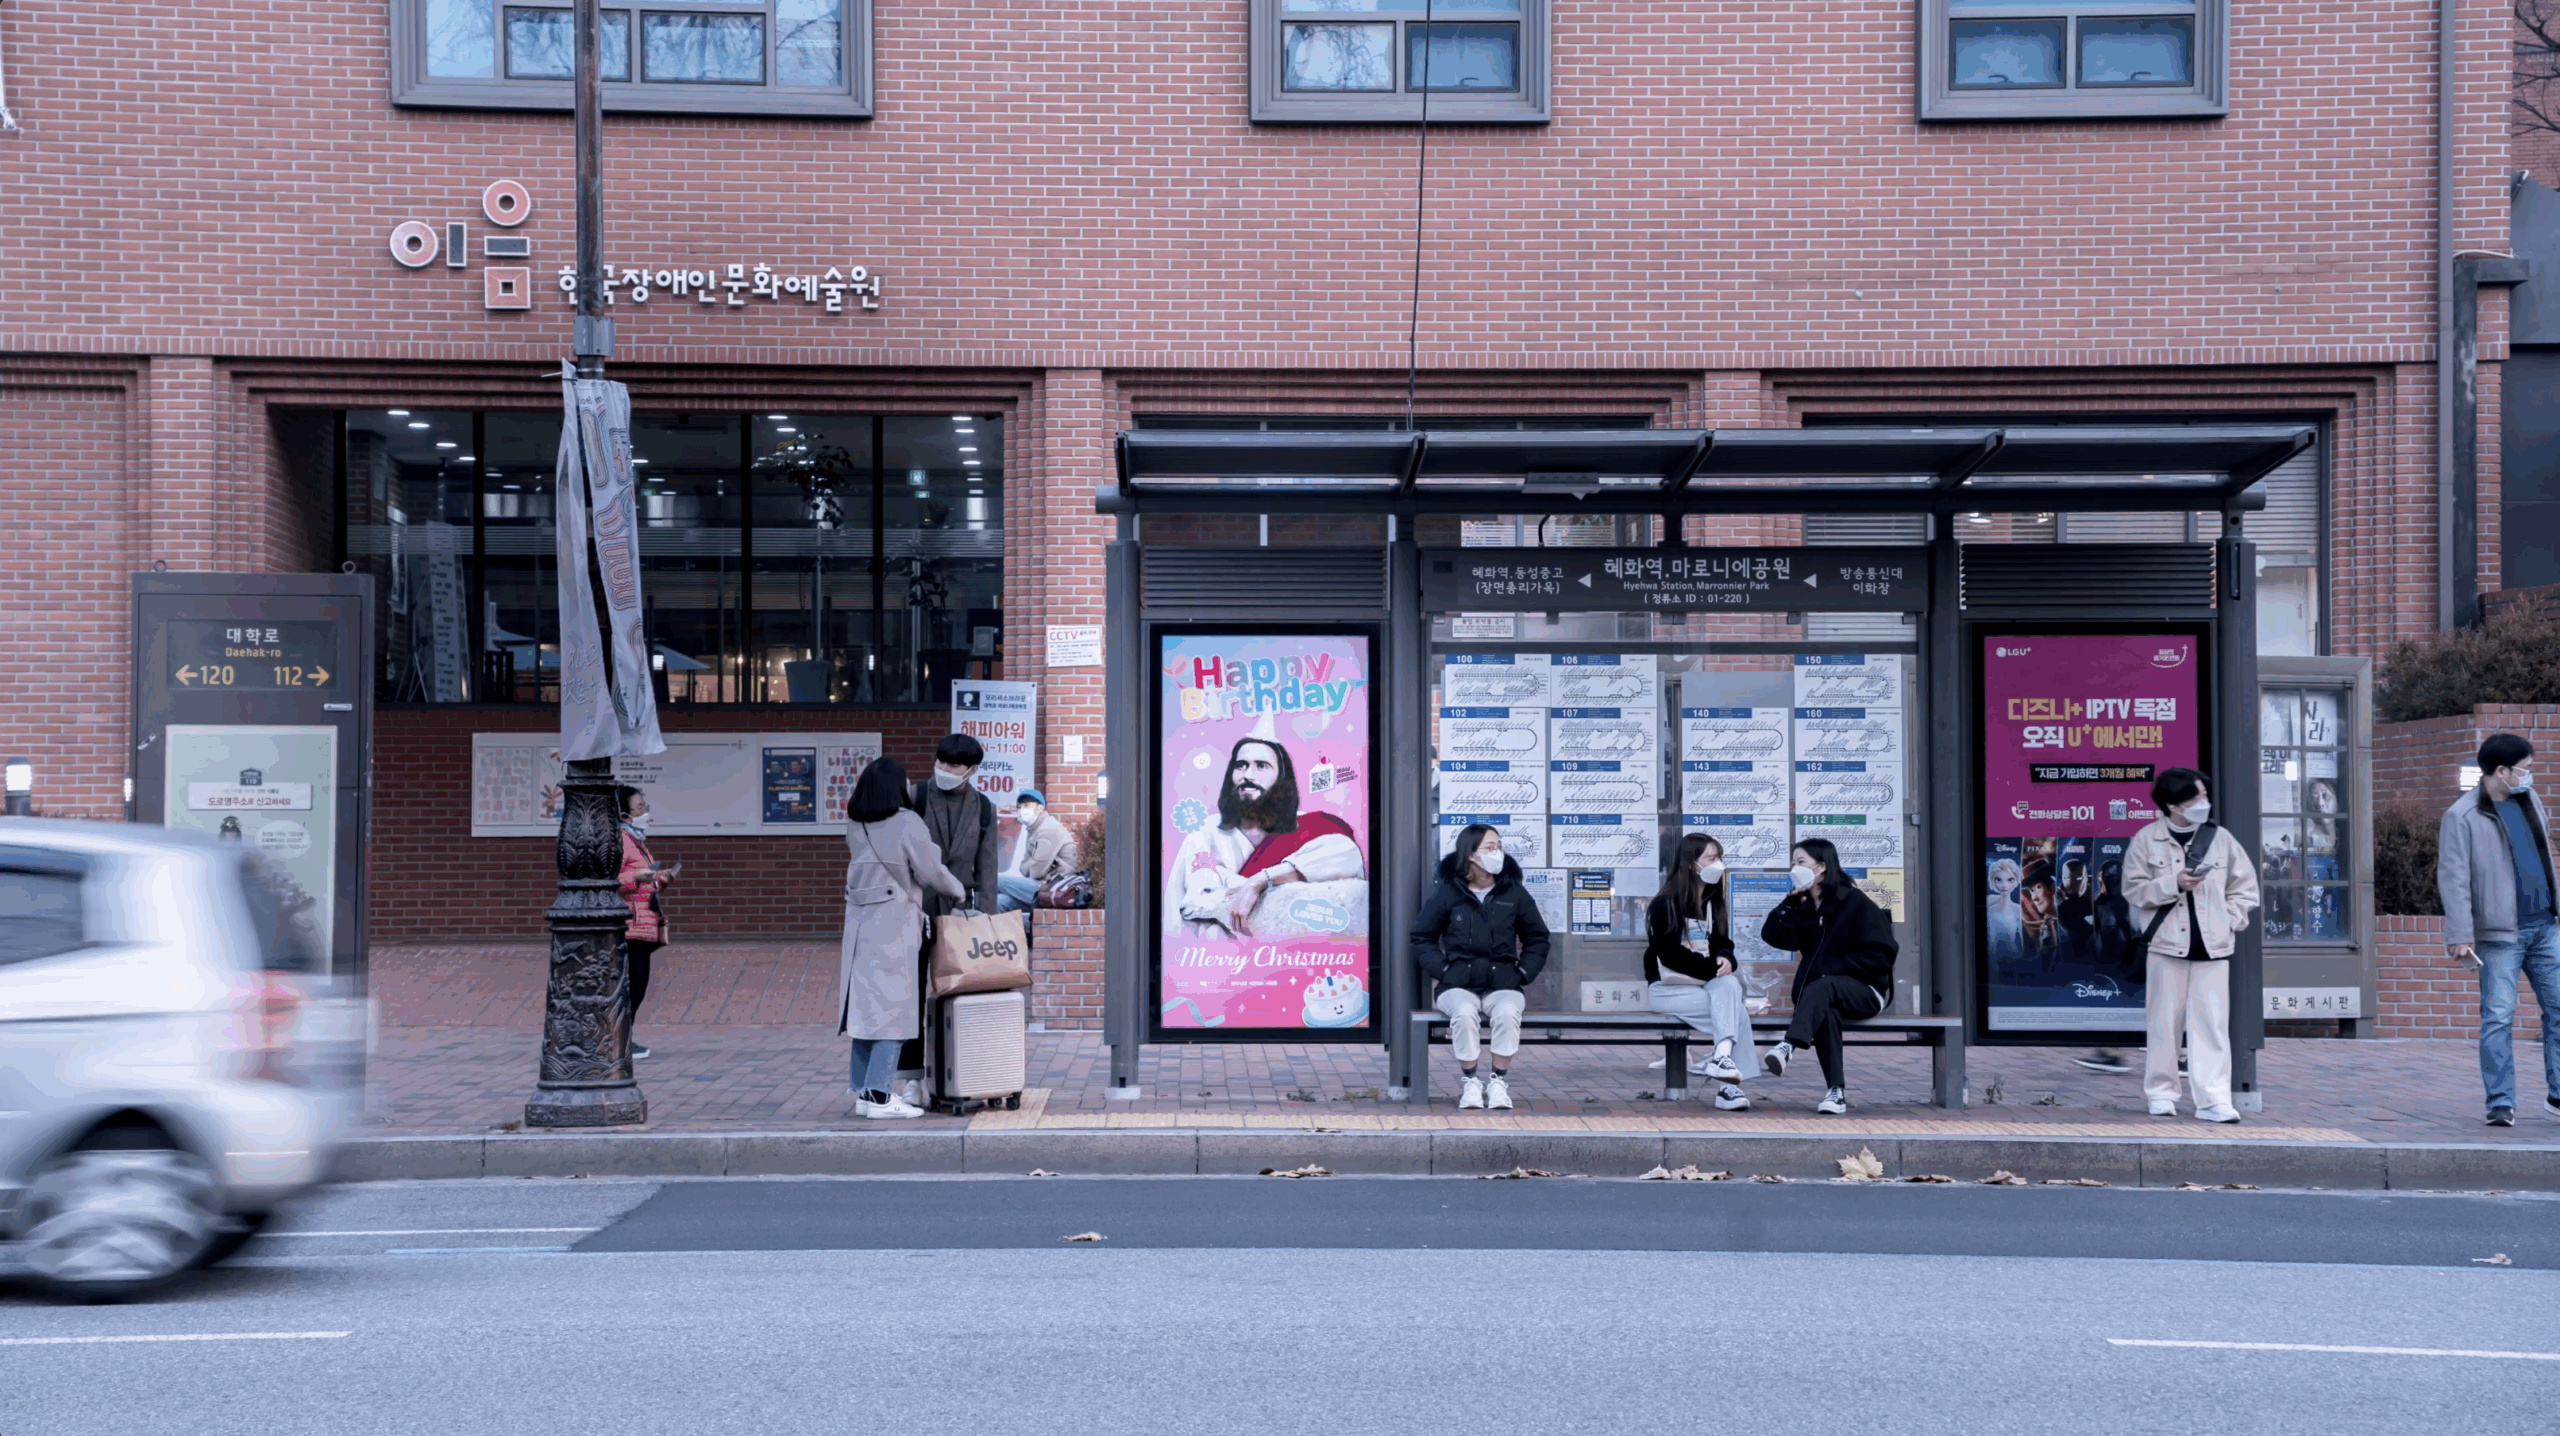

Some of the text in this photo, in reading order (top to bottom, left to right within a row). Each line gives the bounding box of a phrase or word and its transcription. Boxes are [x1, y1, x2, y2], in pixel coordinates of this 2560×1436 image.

[1472, 566, 1564, 580] 혜화역.동성중고
[1604, 556, 1792, 580] 혜화역.마로니에공원
[1840, 566, 1904, 581] 방송통신대
[1475, 581, 1561, 595] (장면총리가옥)
[1623, 581, 1658, 592] Hyehwa
[1750, 581, 1770, 591] Park
[1852, 581, 1891, 596] 이화장
[1652, 593, 1682, 604] 정류소
[1686, 594, 1696, 603] ID
[1707, 593, 1742, 603] 01-220
[226, 627, 280, 646] 대학로
[1049, 631, 1078, 641] CCTV
[225, 646, 282, 658] Daehak-ro
[1456, 655, 1472, 664] 100
[1561, 655, 1578, 665] 106
[1805, 655, 1822, 664] 150
[200, 665, 234, 685] 120
[273, 666, 302, 686] 112
[1193, 652, 1335, 689] Happy
[1180, 677, 1352, 721] Birthday
[1450, 708, 1467, 718] 102
[1562, 708, 1578, 718] 107
[1692, 709, 1710, 718] 140
[1805, 709, 1822, 718] 160
[2008, 697, 2176, 721] 디즈니+ IPTV 독점
[960, 720, 1026, 740] 해피아워
[2022, 726, 2064, 749] 오직
[980, 743, 1026, 754] N~11:00
[1450, 762, 1467, 771] 104
[1561, 762, 1578, 771] 109
[1693, 762, 1710, 771] 143
[1806, 762, 1823, 771] 162
[2060, 766, 2099, 779] 가입하면
[2099, 767, 2125, 779] 3개월
[977, 775, 1014, 793] 500
[208, 797, 292, 807] 도로명주소로 신고하세요
[1181, 805, 1194, 816] 12
[2029, 805, 2095, 820] 전화상담은 101
[2128, 809, 2155, 820] 이벤트
[1185, 815, 1198, 827] 25
[1450, 815, 1468, 825] 273
[1562, 815, 1579, 824] 710
[1693, 815, 1710, 825] 301
[1803, 815, 1827, 824] 2112
[1994, 843, 2018, 854] Disney
[1324, 915, 1344, 927] YOU
[967, 937, 1018, 961] Jeep
[1174, 945, 1356, 975] Merry Christmas
[2072, 982, 2122, 1001] Disney+
[2270, 995, 2349, 1011] 문화게시판
